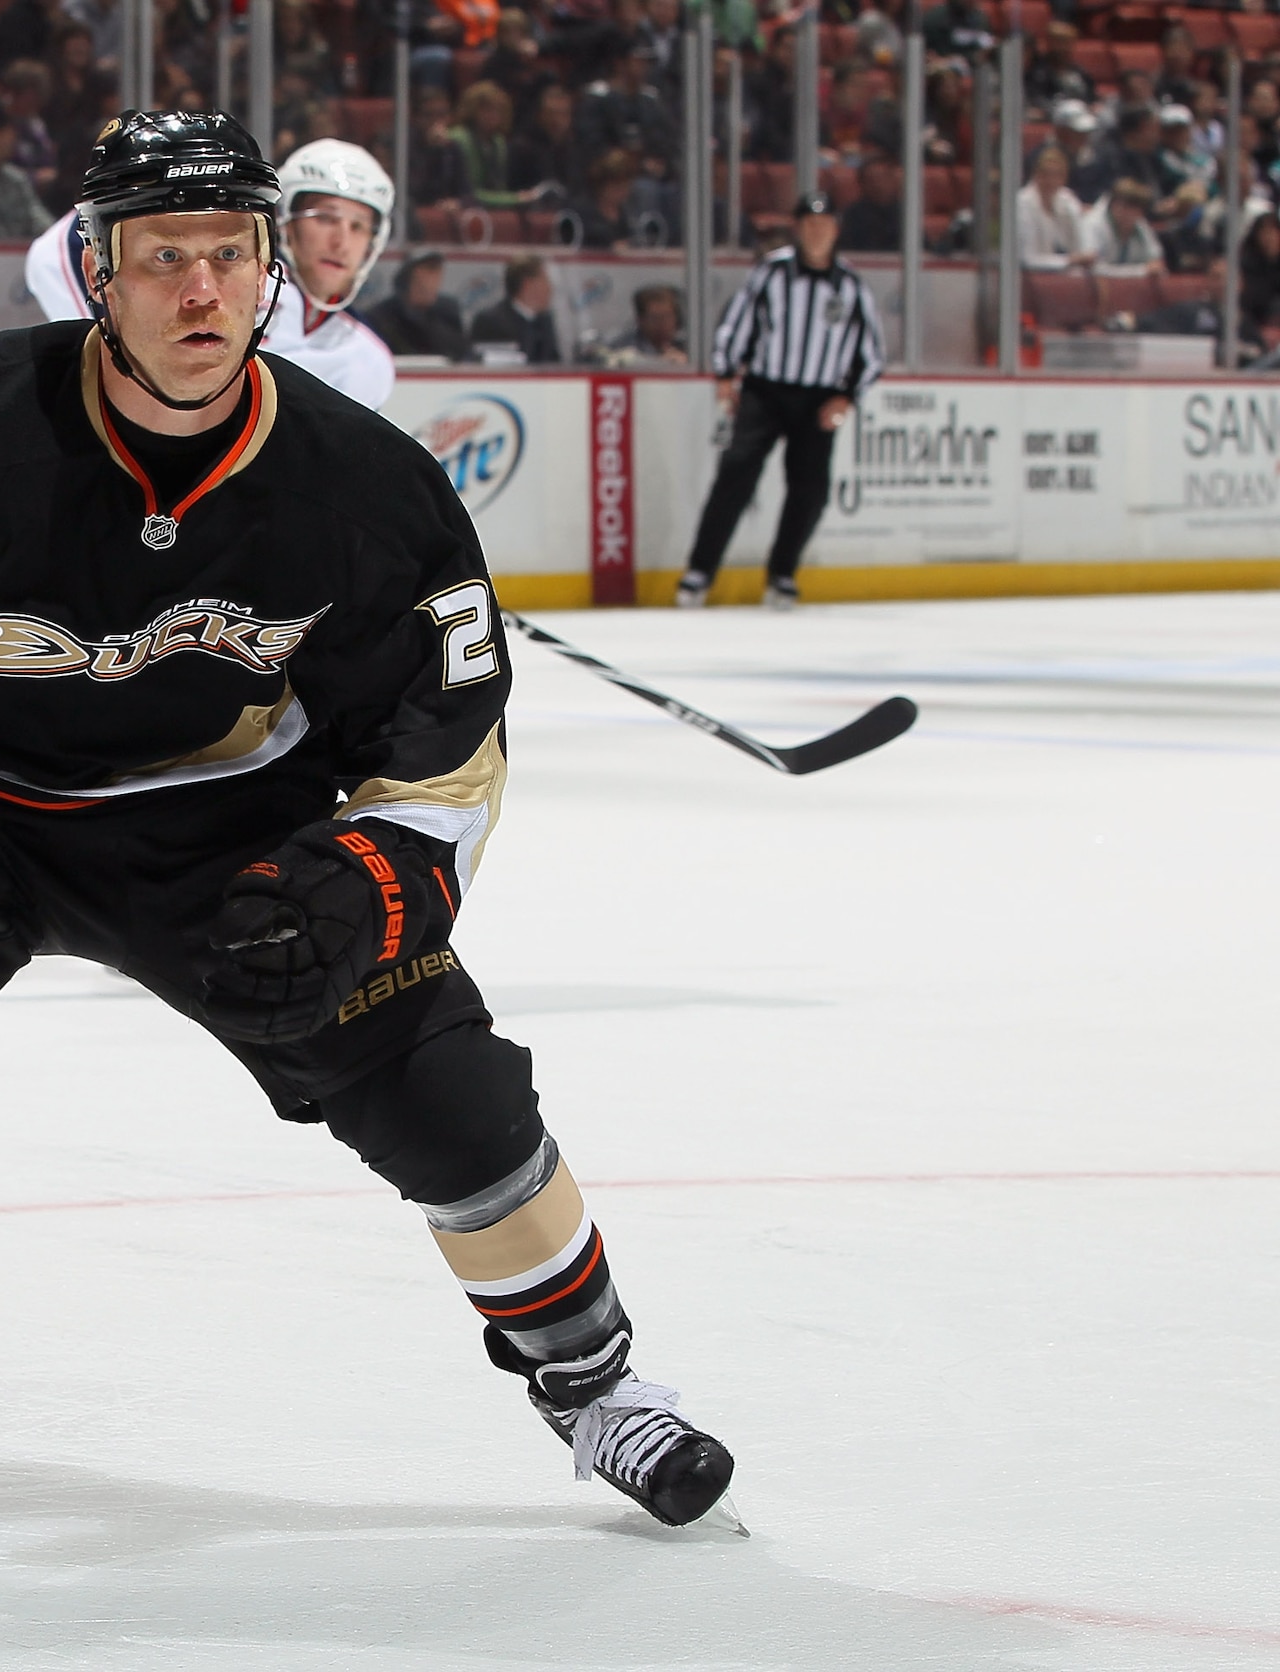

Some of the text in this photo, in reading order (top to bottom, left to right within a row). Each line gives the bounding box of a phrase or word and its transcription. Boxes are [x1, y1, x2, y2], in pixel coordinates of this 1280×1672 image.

[166, 160, 234, 179] BAUER
[595, 384, 629, 566] Reebok
[149, 524, 173, 541] NHL
[413, 577, 501, 690] 2
[333, 831, 405, 964] BAUER
[338, 949, 461, 1026] BAUER
[567, 1353, 622, 1387] BAUER
